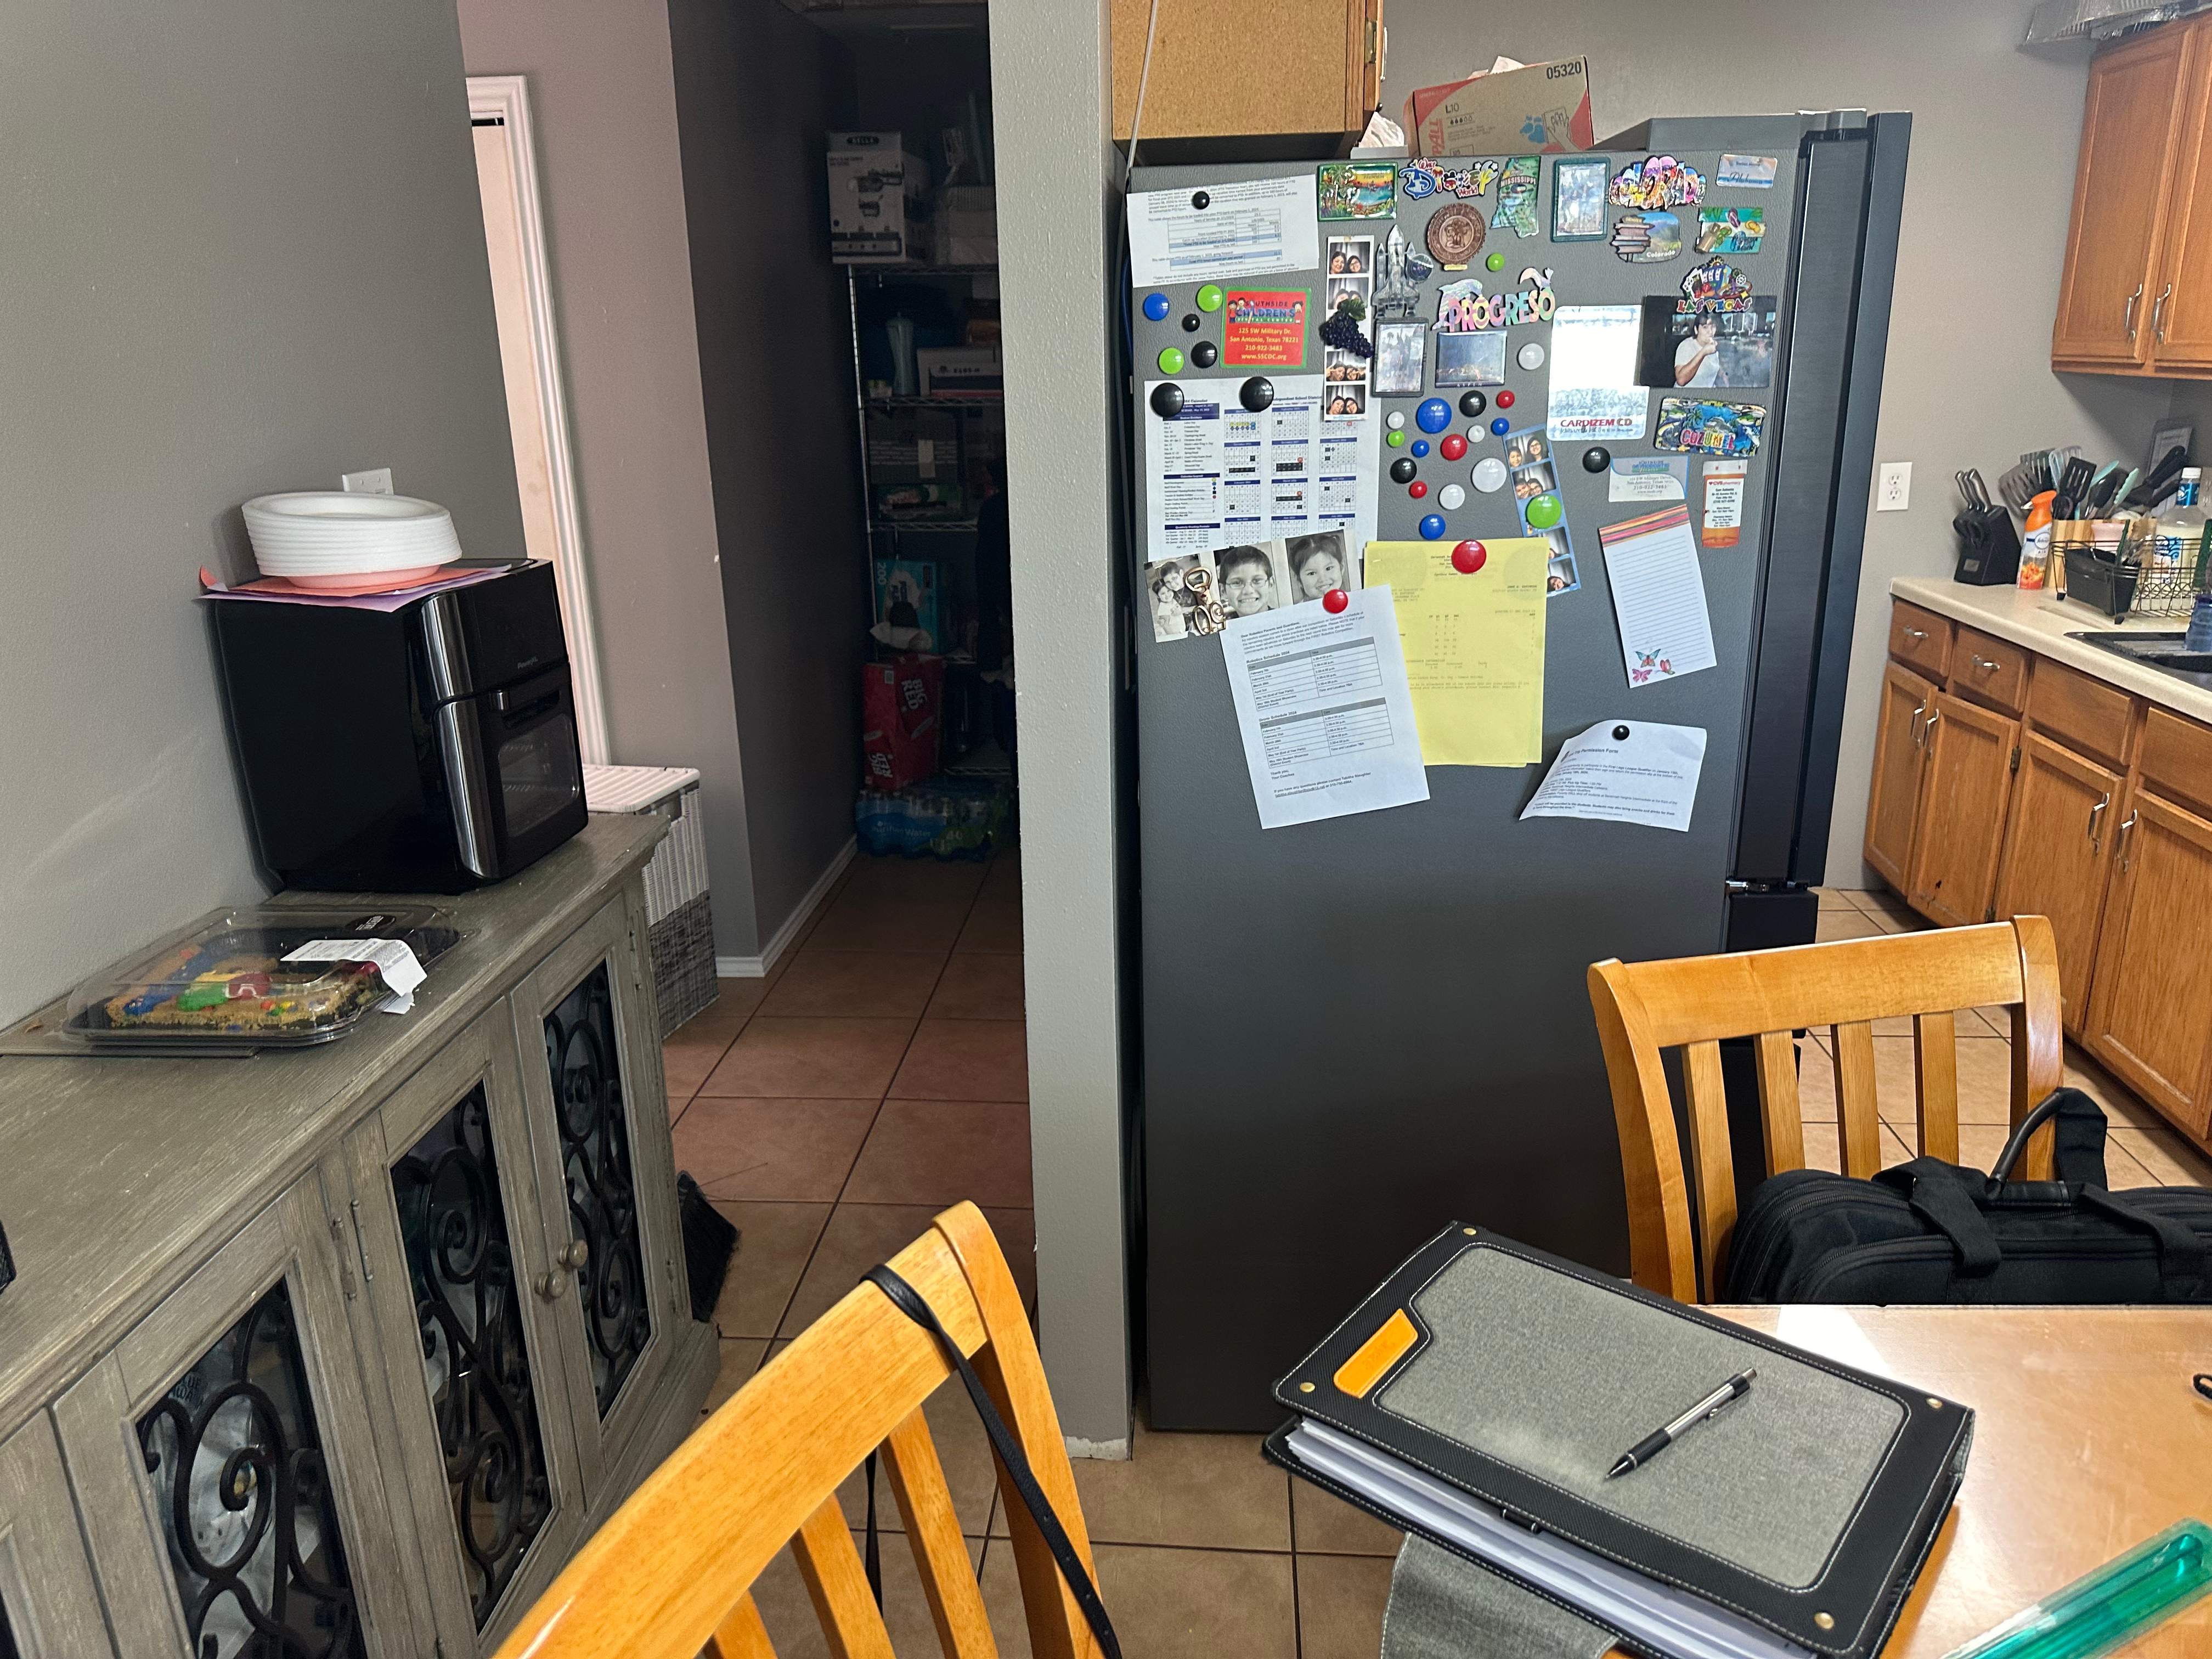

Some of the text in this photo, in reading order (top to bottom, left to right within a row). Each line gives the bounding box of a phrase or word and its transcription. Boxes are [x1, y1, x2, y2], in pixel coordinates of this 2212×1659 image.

[1546, 61, 1582, 80] 05320
[1445, 103, 1459, 114] L10
[1500, 175, 1536, 188] MISSISSIPPI
[1456, 186, 1479, 199] World
[1646, 249, 1676, 258] Colorado
[1448, 286, 1556, 332] PROGRESO
[1677, 297, 1753, 314] LAS VEGAS
[1560, 417, 1633, 427] CARDIZEM CD
[1680, 429, 1736, 450] COZUMEL
[877, 562, 887, 586] 200
[901, 679, 919, 710] RED
